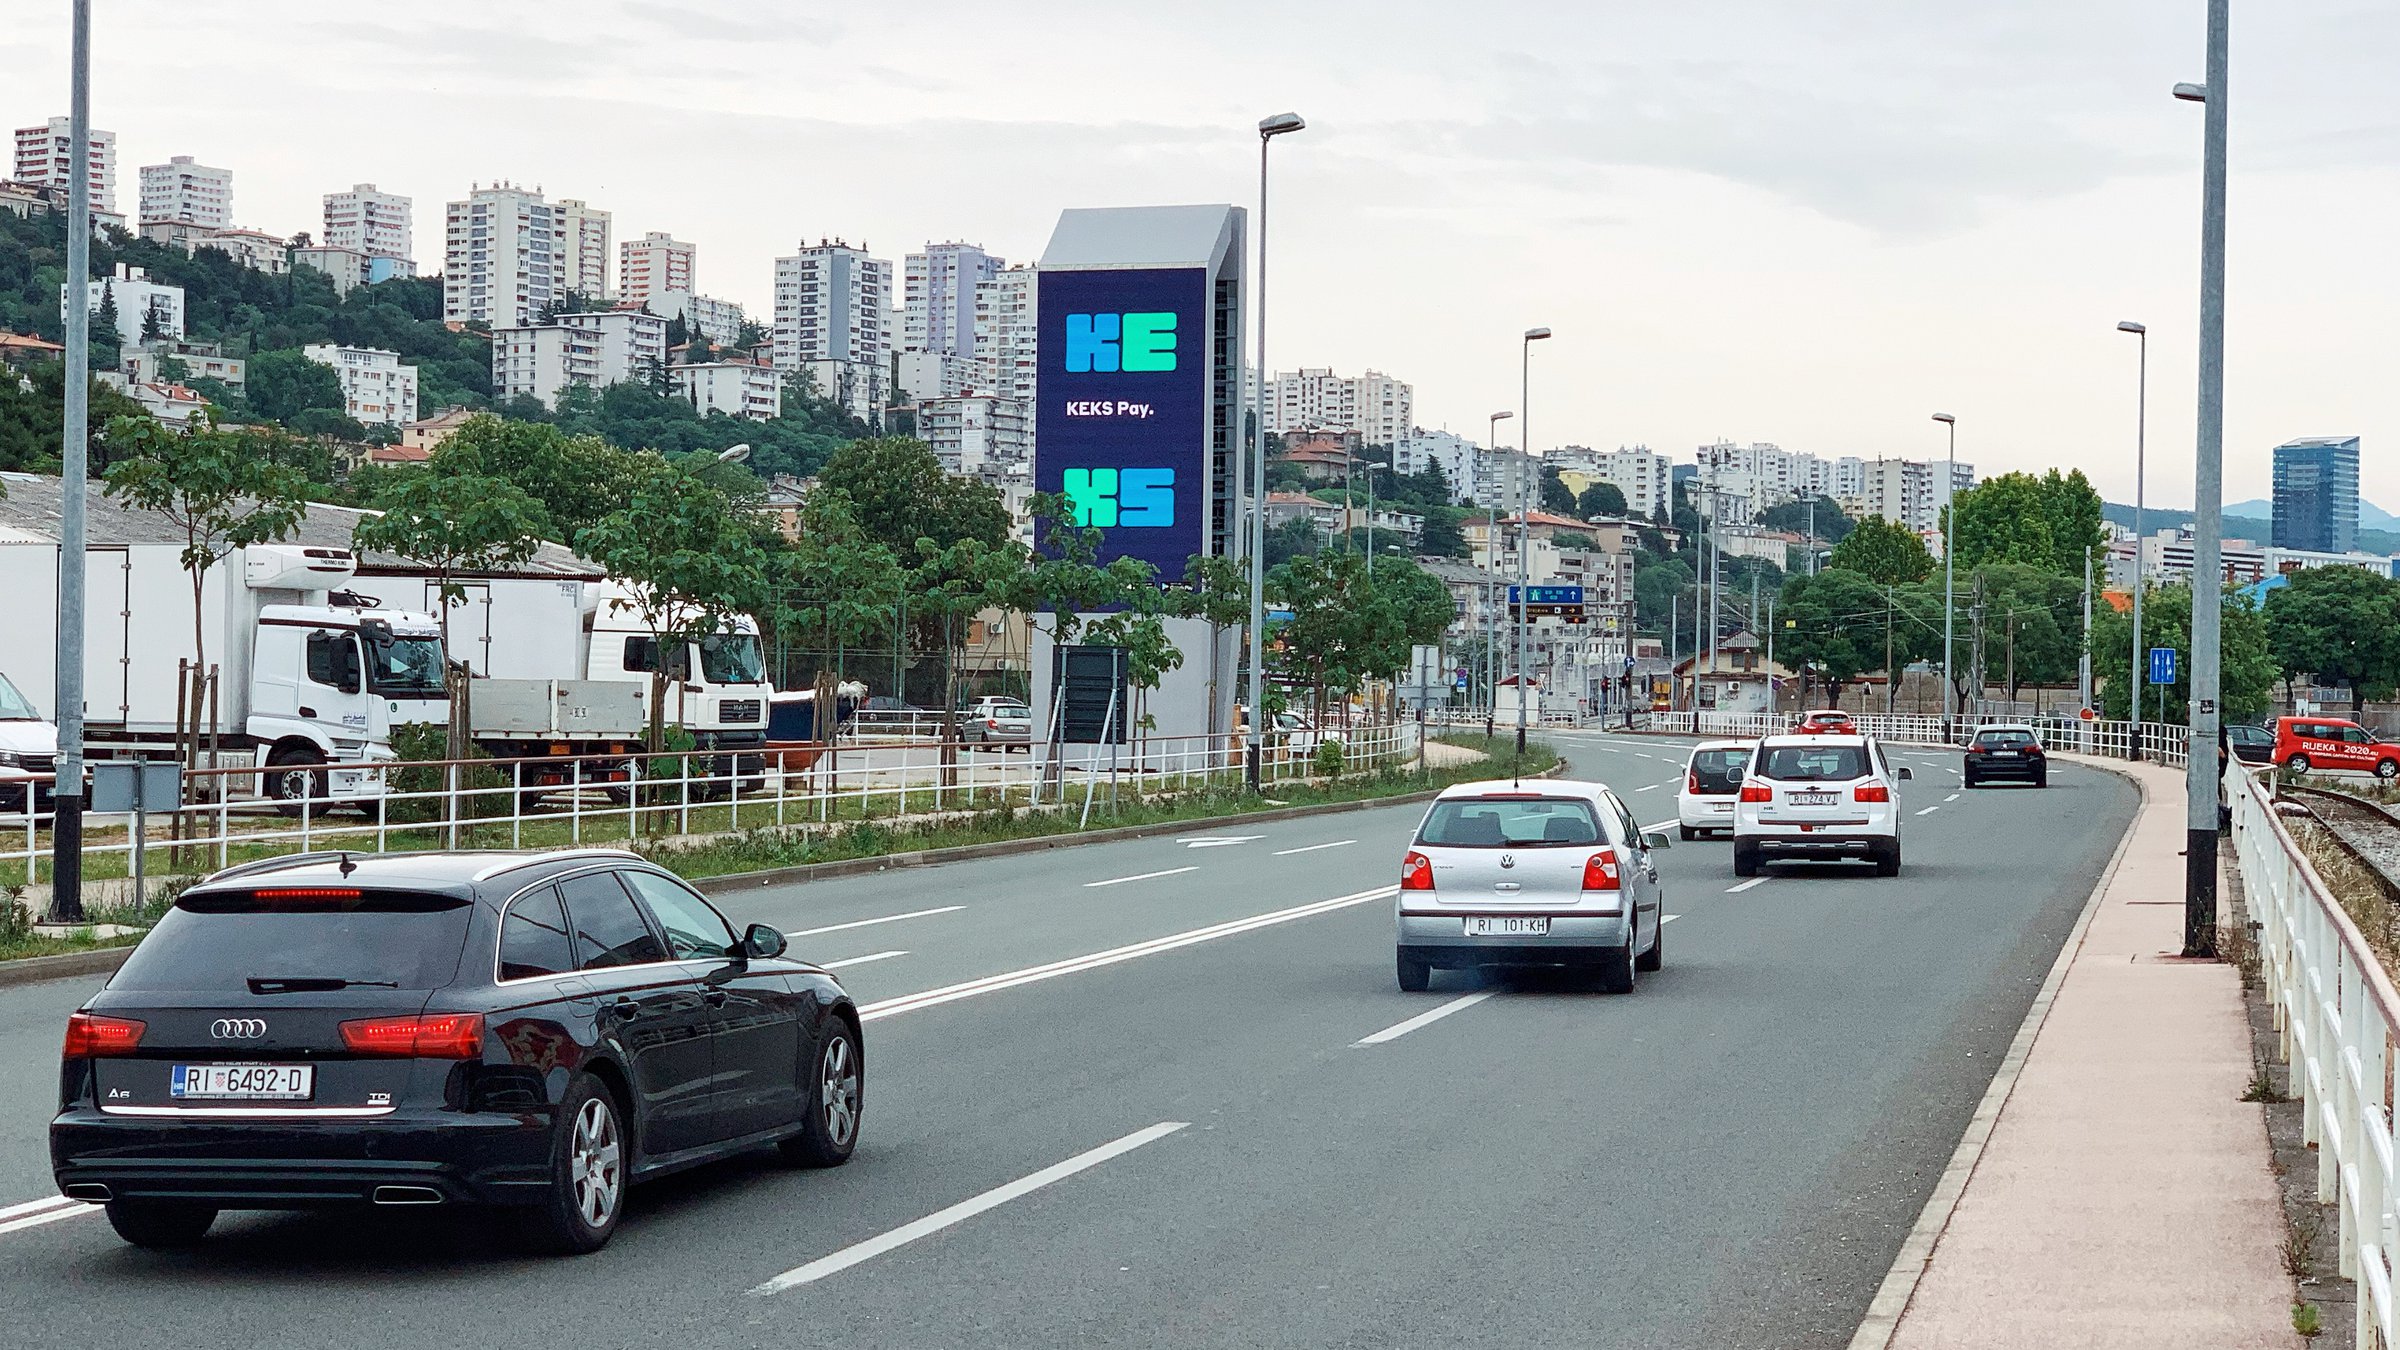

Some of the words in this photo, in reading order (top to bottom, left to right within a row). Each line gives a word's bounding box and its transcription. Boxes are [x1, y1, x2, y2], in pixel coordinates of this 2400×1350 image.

[1065, 312, 1178, 373] KE
[1066, 401, 1114, 416] KEKS
[1117, 401, 1155, 419] Pay.
[1063, 467, 1176, 528] KS
[2302, 741, 2336, 752] RIJEKA
[1794, 794, 1803, 804] RI
[1478, 919, 1491, 932] RI
[1504, 919, 1545, 932] 101-KH
[173, 1082, 184, 1090] HR
[187, 1068, 209, 1092] RI
[227, 1068, 301, 1093] 6492-D
[108, 1088, 131, 1099] A6
[368, 1092, 391, 1100] TDI
